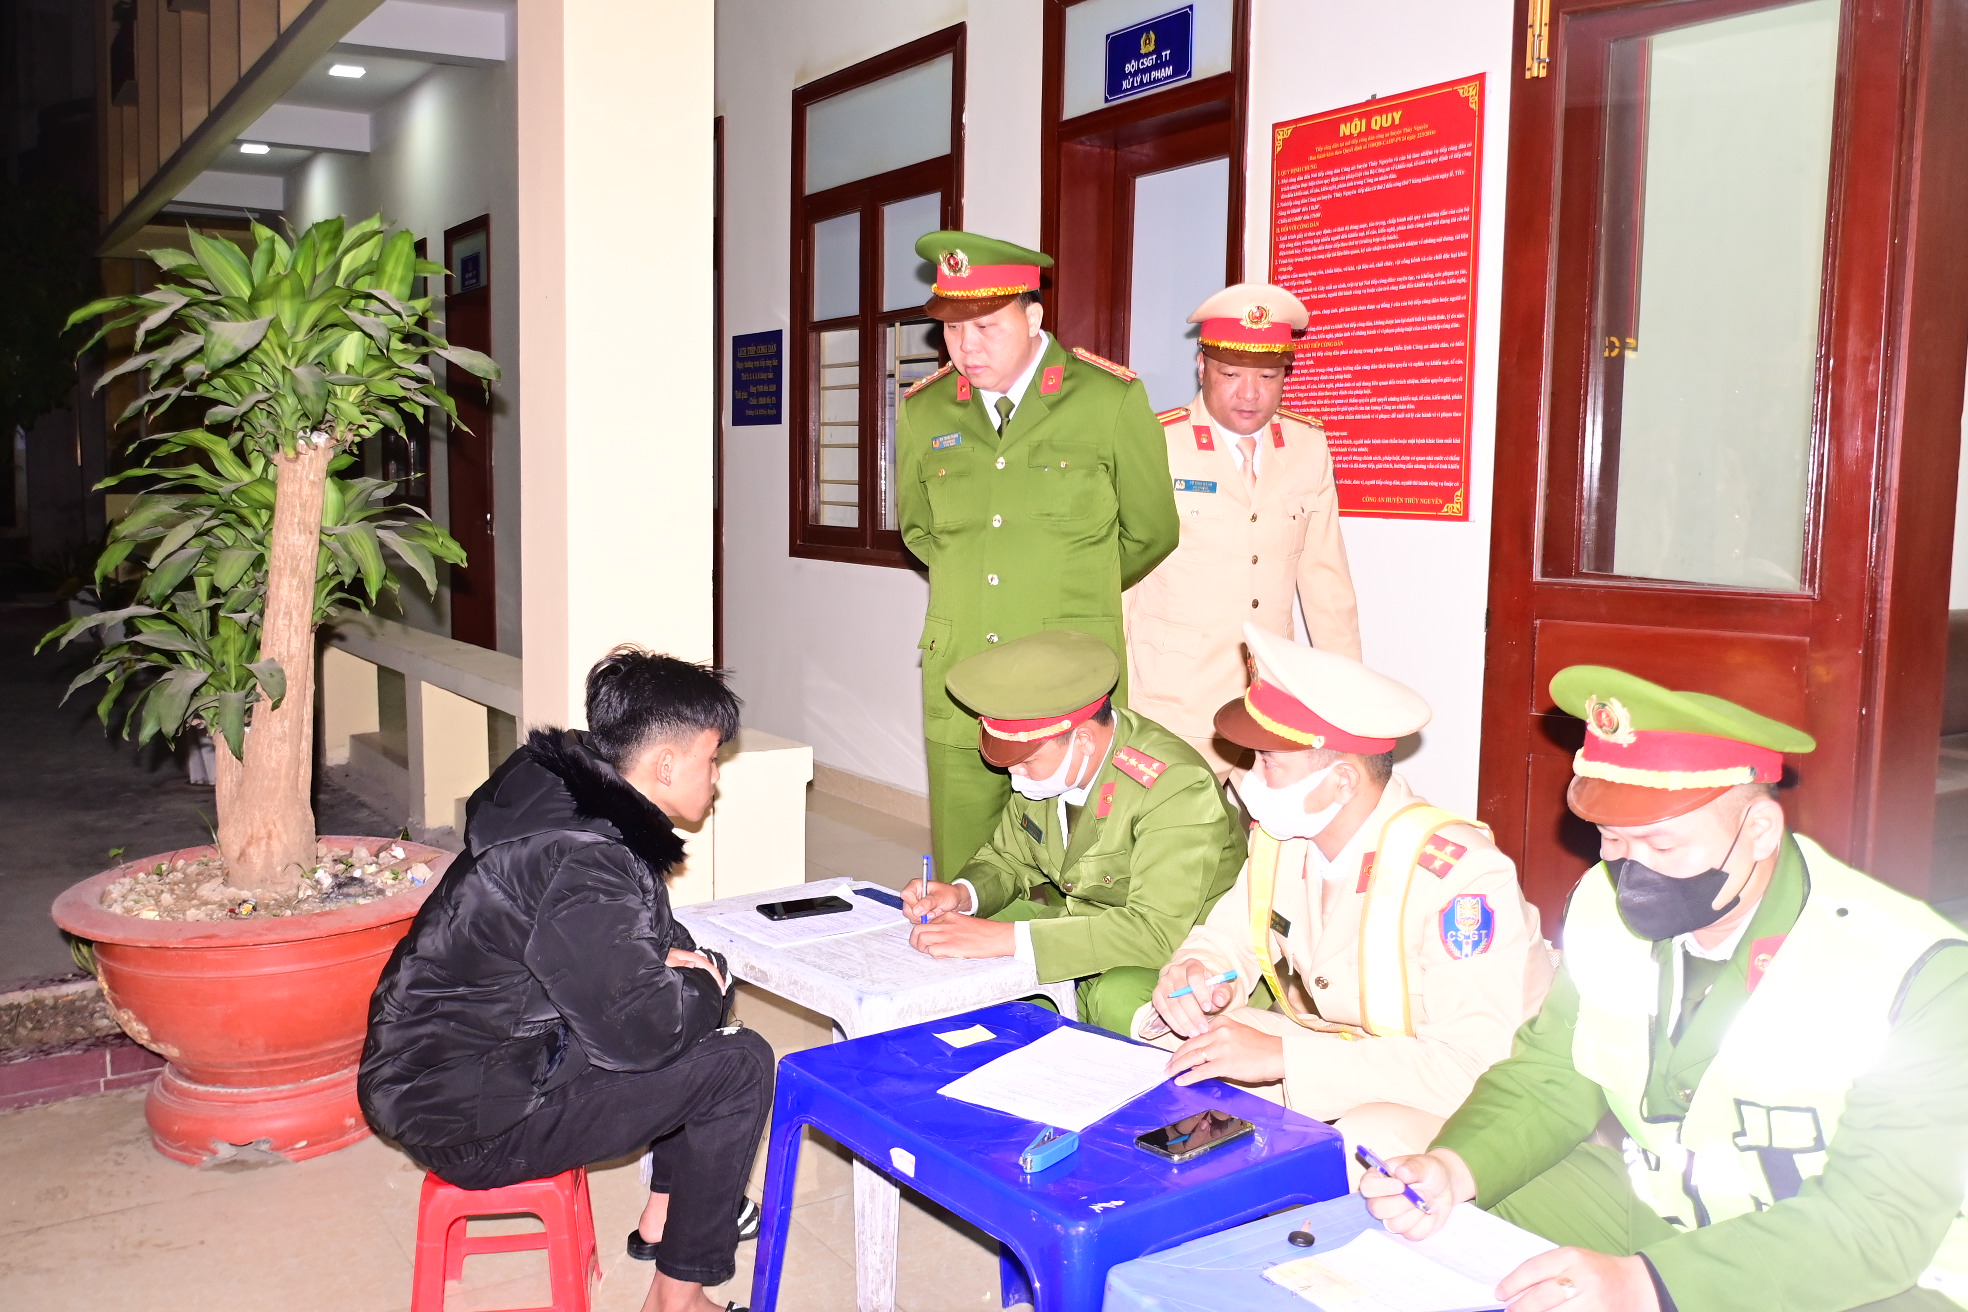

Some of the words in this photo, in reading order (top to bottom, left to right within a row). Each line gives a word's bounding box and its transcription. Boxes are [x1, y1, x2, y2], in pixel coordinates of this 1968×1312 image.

[1125, 59, 1137, 74] ĐỘI
[1139, 54, 1156, 69] CSGT
[1162, 50, 1170, 62] TT
[1122, 75, 1133, 90] XỬ
[1134, 73, 1141, 87] LÝ
[1142, 72, 1149, 83] VI
[1151, 66, 1173, 80] PHẠM
[1340, 118, 1366, 137] NỘI
[1371, 111, 1402, 131] QUY
[1448, 930, 1487, 942] CSGT
